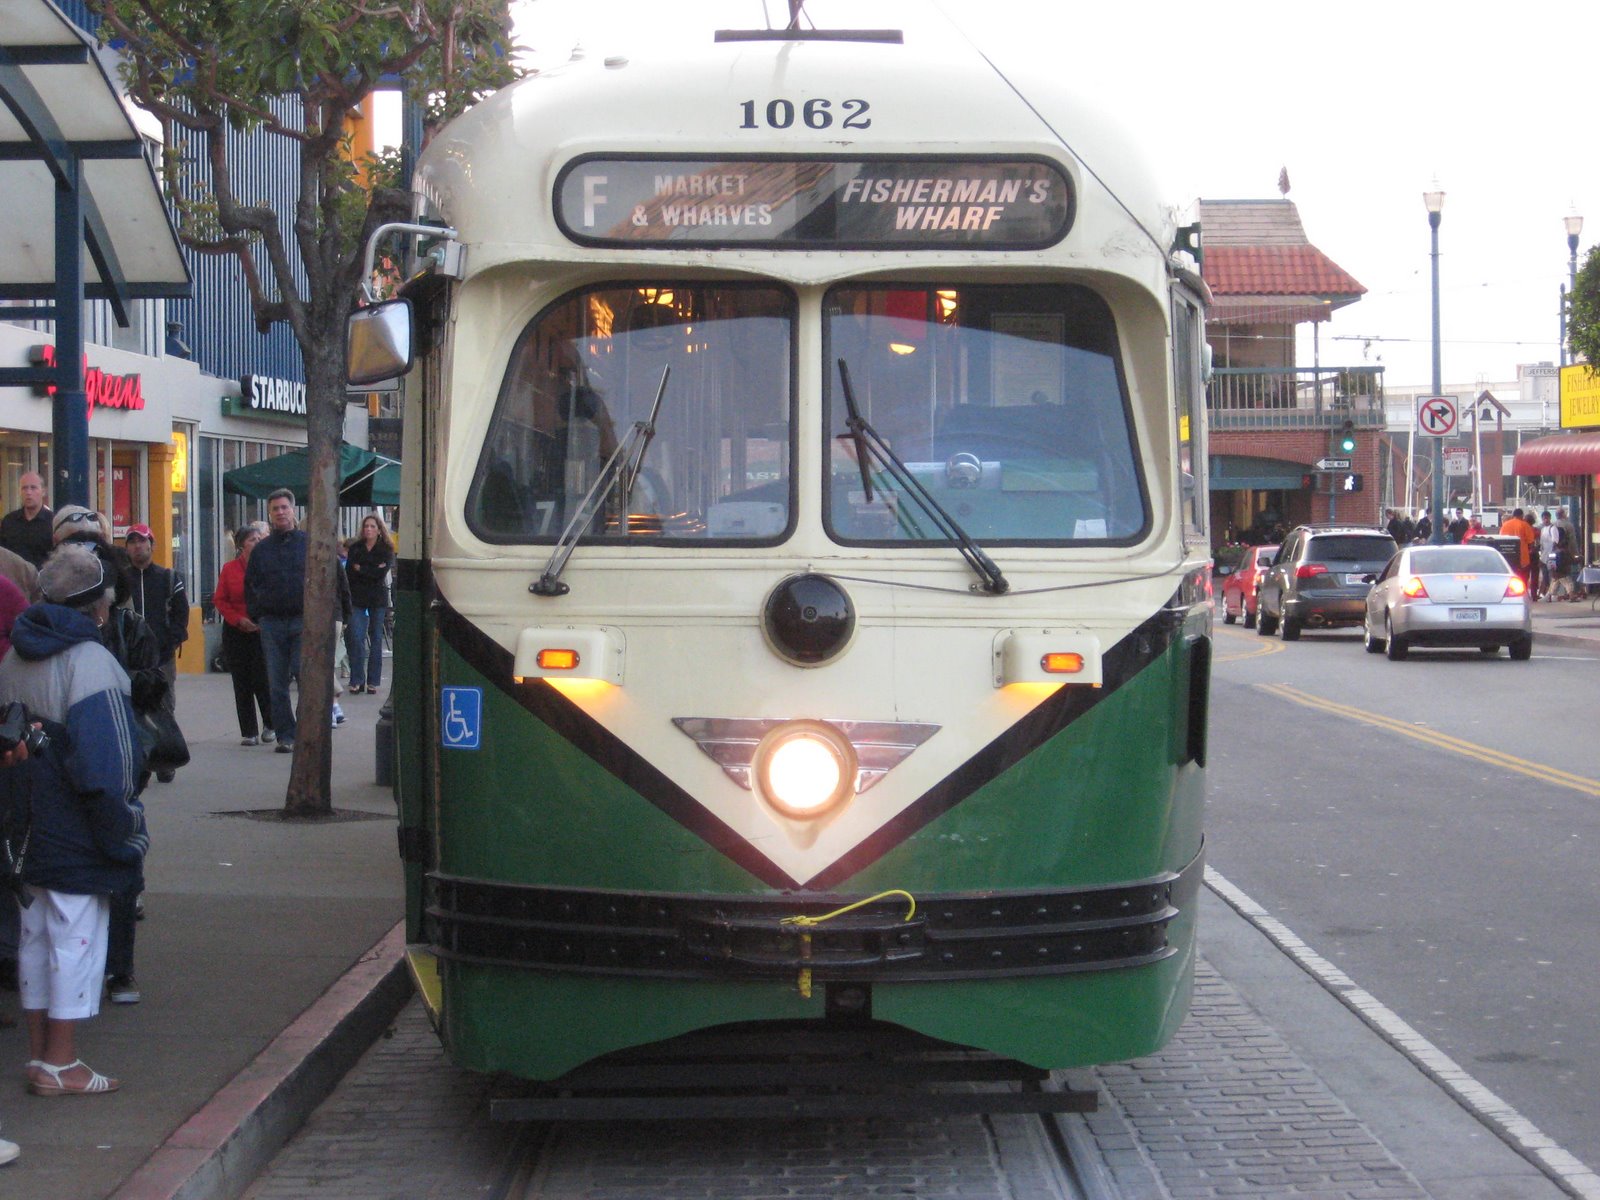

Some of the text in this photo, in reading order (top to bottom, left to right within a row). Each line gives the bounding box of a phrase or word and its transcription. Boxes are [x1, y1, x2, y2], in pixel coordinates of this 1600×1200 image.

[739, 98, 872, 129] 1062
[654, 175, 748, 196] MARKET
[842, 178, 1050, 203] FISHERMAN'S
[583, 175, 608, 227] F
[632, 204, 772, 226] & WHARVES
[895, 206, 1005, 230] WHARF
[536, 501, 555, 535] 7
